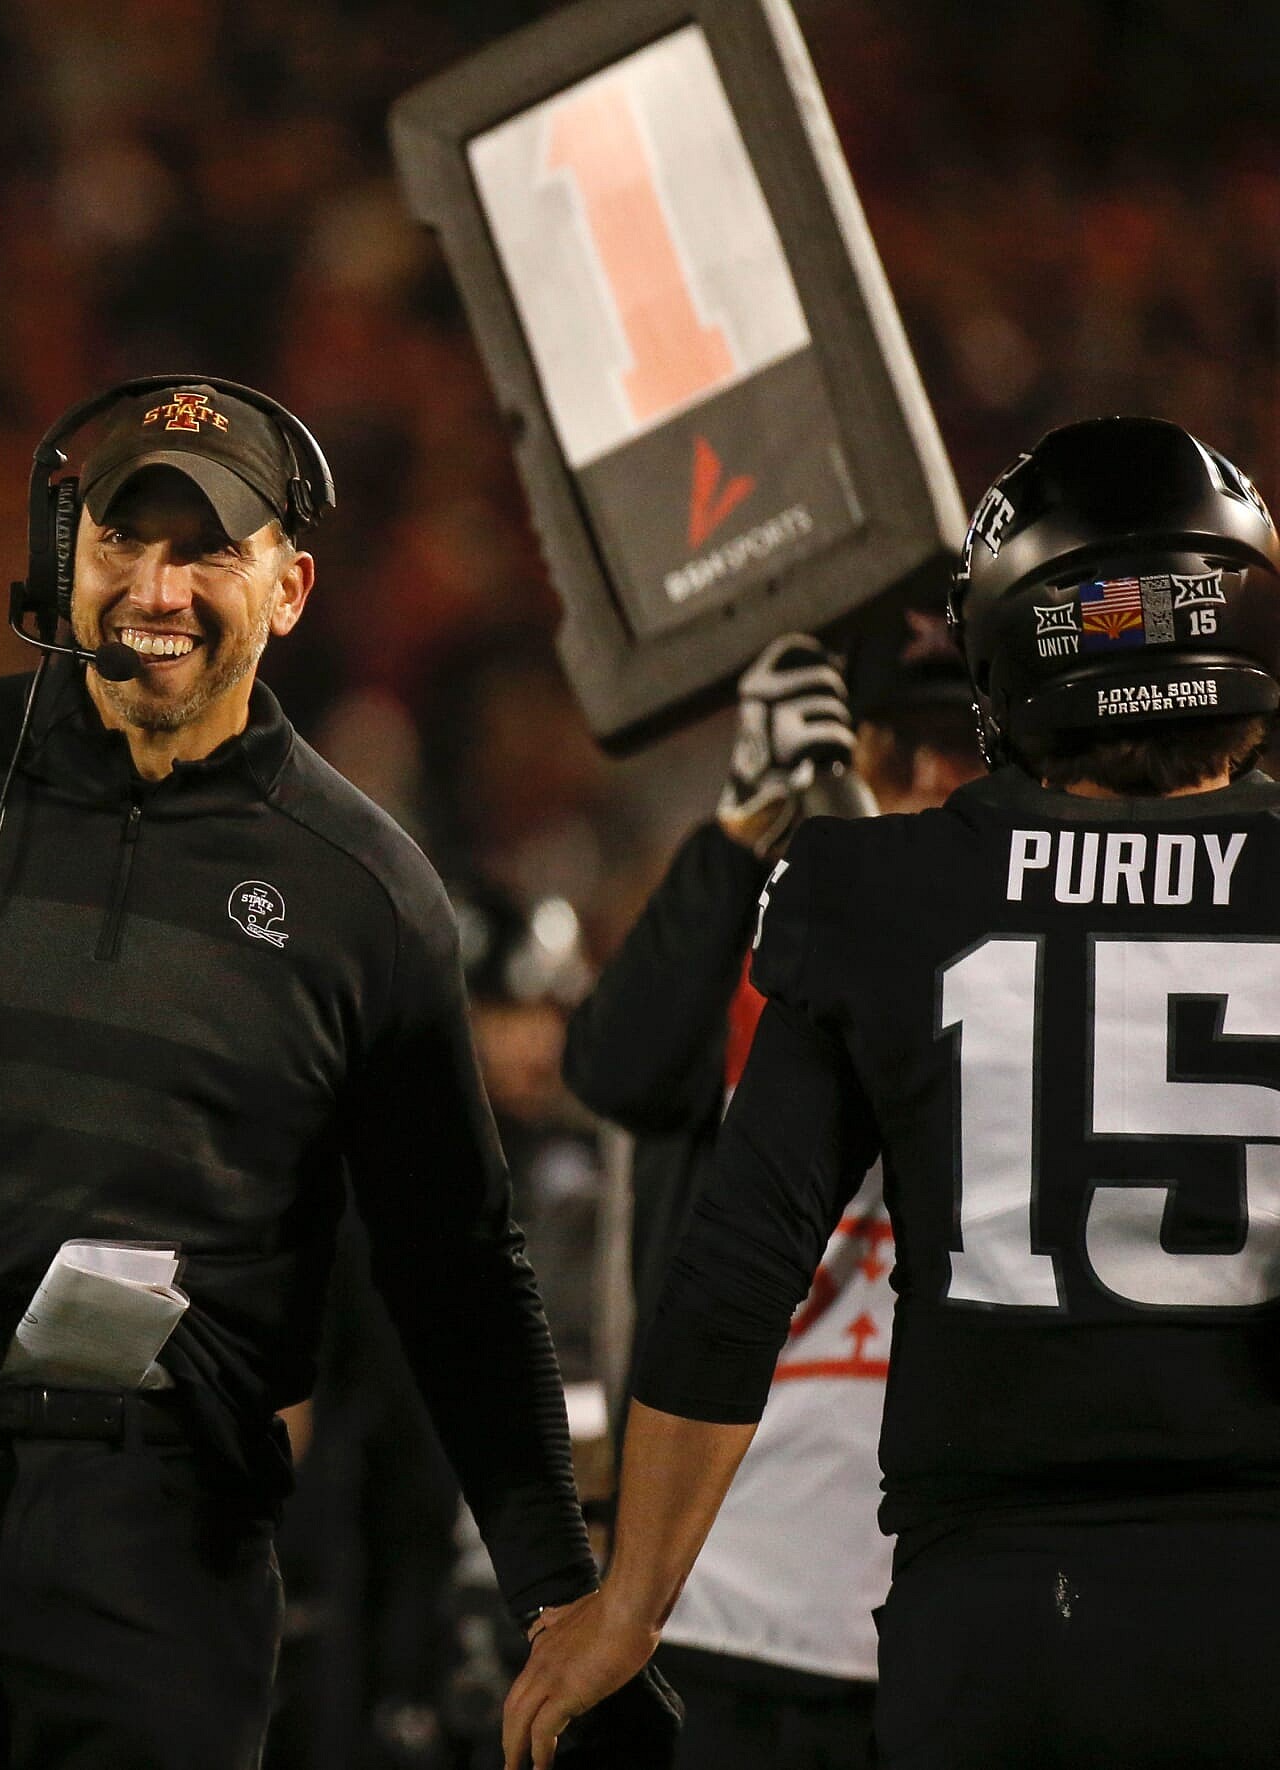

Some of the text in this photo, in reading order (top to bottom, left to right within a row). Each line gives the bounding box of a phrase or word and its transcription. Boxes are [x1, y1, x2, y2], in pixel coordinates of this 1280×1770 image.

[542, 85, 738, 425] 1
[143, 402, 230, 433] STATE
[1190, 609, 1217, 636] 15
[1037, 634, 1079, 657] UNITY
[1097, 679, 1218, 705] LOYAL SONS
[1097, 694, 1218, 717] FOREVER TRUE
[1006, 829, 1248, 905] PURDY
[241, 894, 274, 912] STATE
[941, 938, 1280, 1307] 15
